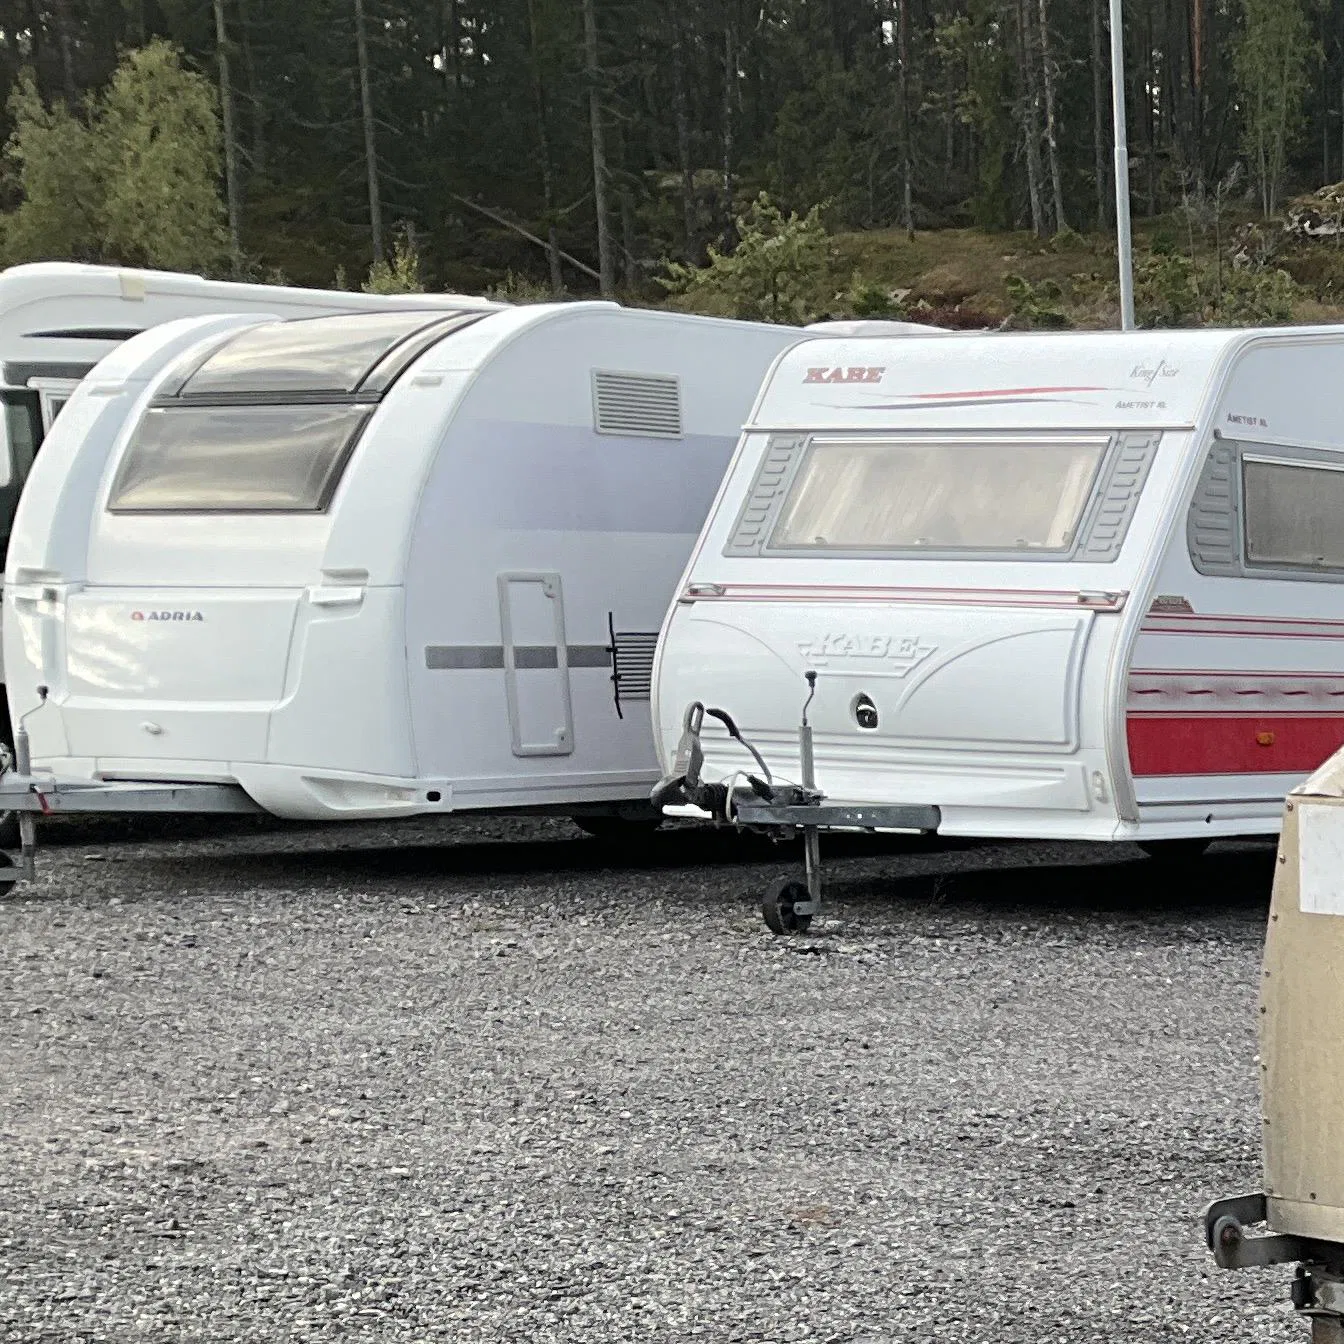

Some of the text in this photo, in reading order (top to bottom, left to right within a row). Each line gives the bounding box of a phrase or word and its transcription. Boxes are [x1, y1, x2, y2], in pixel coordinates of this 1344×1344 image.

[801, 366, 886, 384] KABE
[148, 611, 204, 621] ADRIA
[811, 633, 919, 658] KABE
